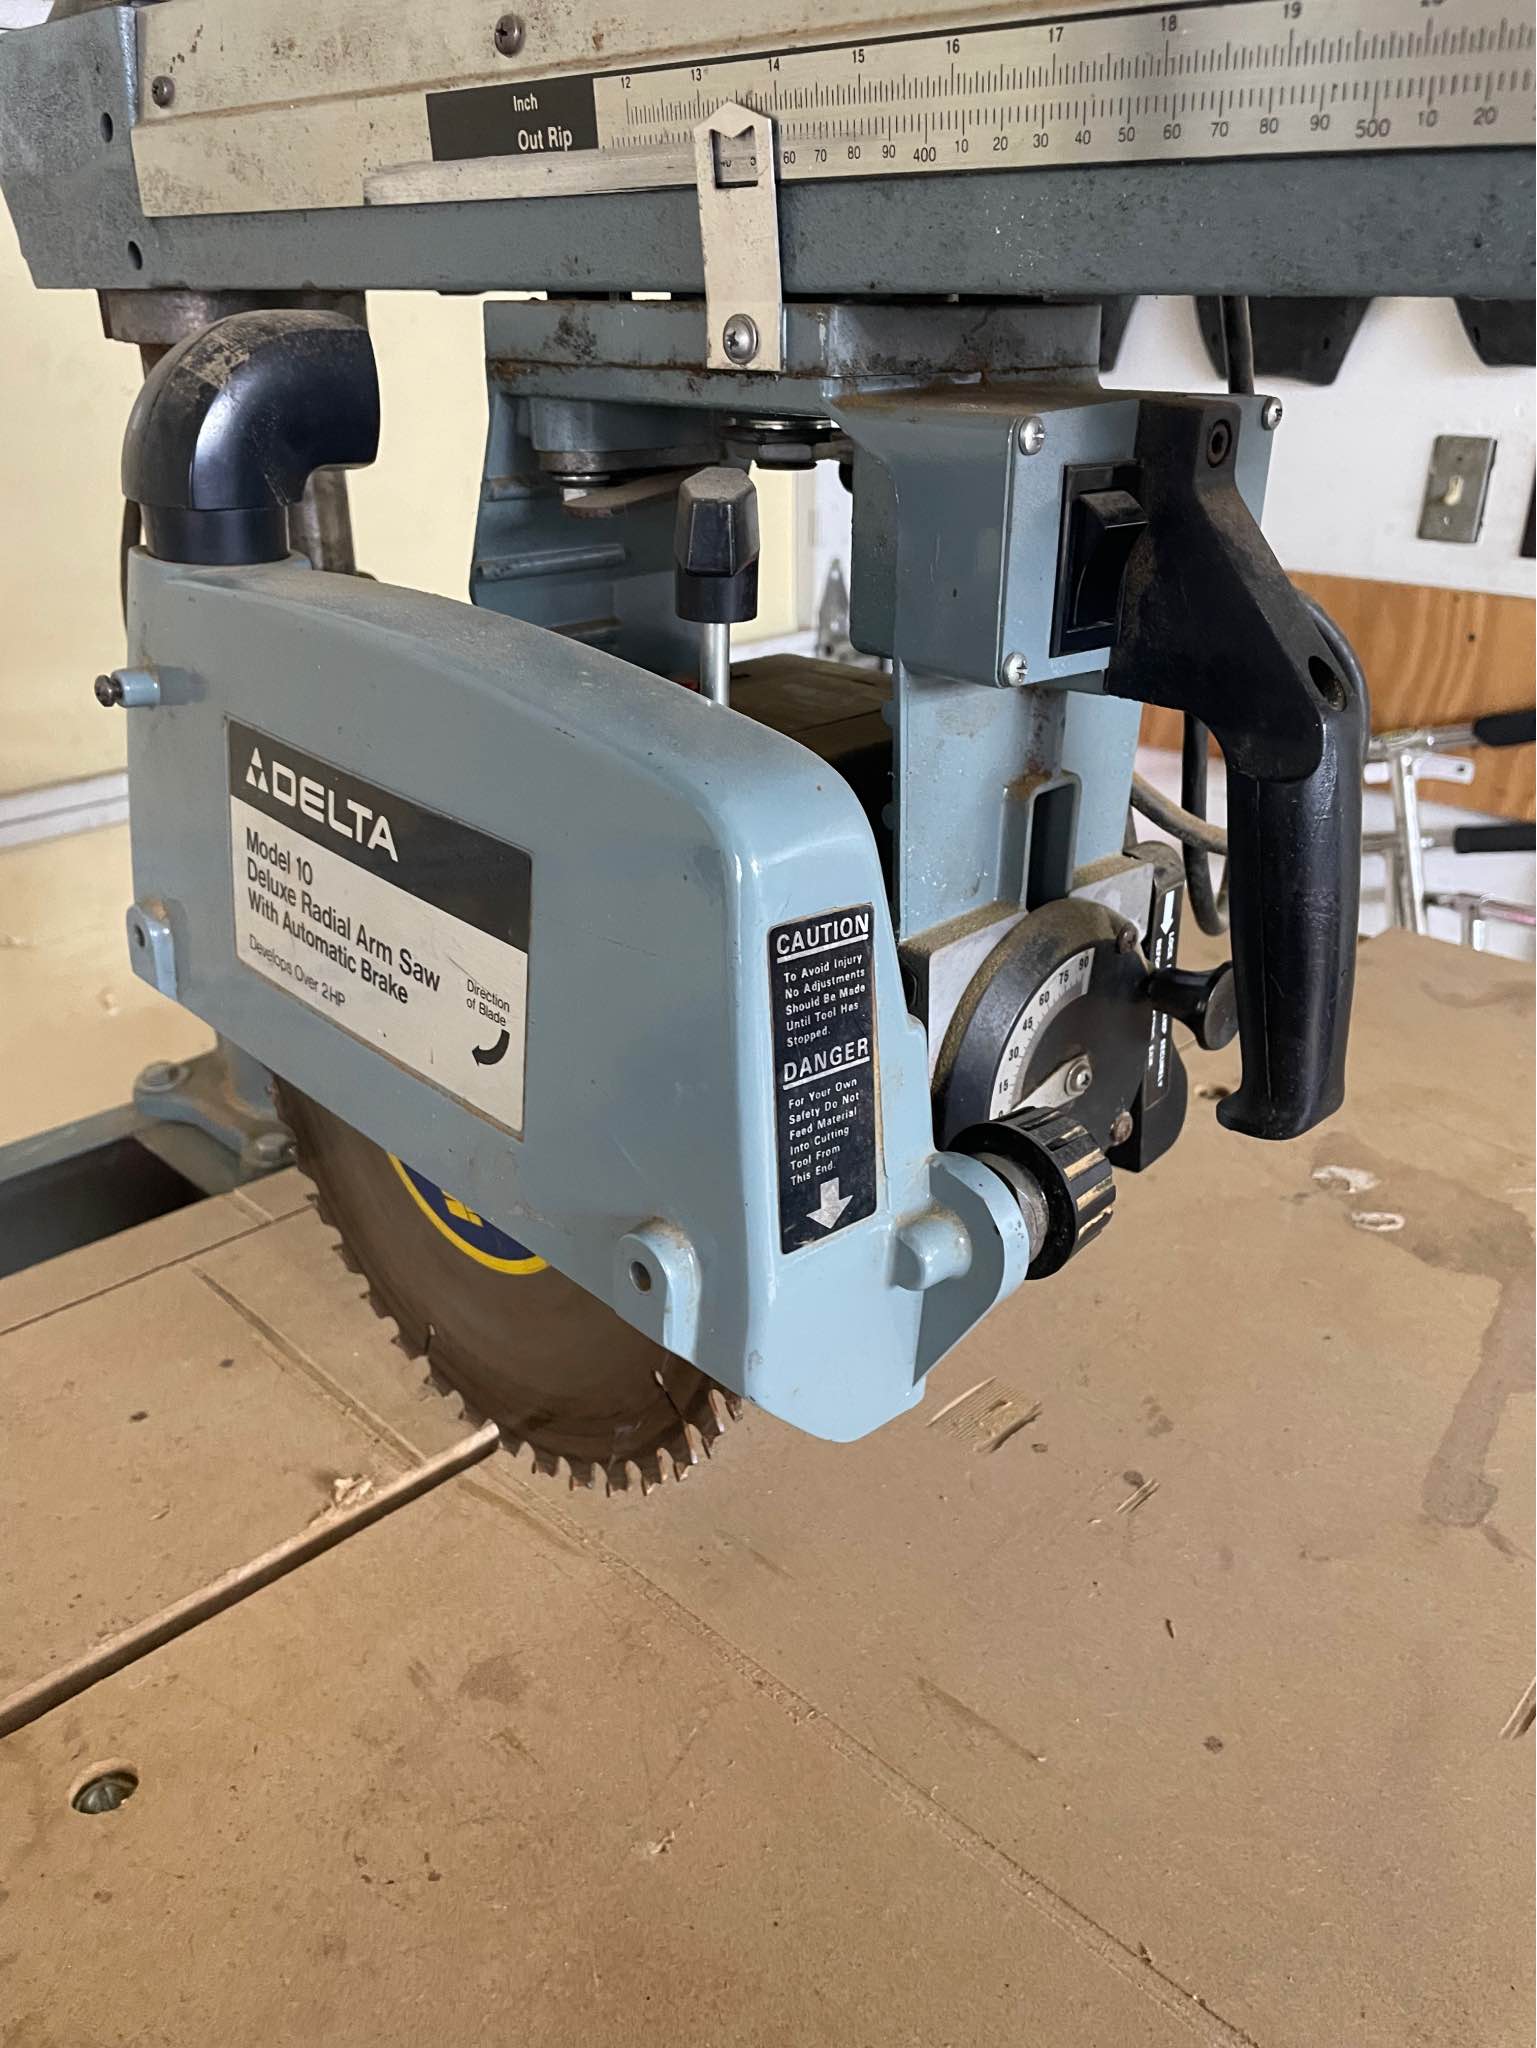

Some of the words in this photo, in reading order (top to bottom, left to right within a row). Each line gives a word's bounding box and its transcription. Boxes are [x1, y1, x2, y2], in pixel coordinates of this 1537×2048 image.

[621, 76, 631, 89] 12
[691, 68, 702, 81] 13
[768, 57, 780, 71] 14
[852, 49, 865, 63] 15
[946, 38, 960, 54] 16
[1049, 26, 1064, 43] 17
[1160, 14, 1177, 32] 18
[1283, 2, 1302, 19] 19
[513, 92, 538, 112] Inch
[518, 129, 544, 150] Out
[547, 125, 573, 152] Rip
[783, 151, 796, 164] 60
[815, 149, 827, 162] 70
[848, 145, 861, 160] 80
[882, 144, 896, 159] 90
[913, 147, 937, 162] 400
[955, 138, 969, 153] 10
[993, 136, 1008, 151] 20
[1033, 132, 1049, 148] 30
[1075, 130, 1091, 144] 40
[1118, 127, 1136, 142] 50
[1163, 123, 1181, 140] 60
[1211, 121, 1229, 138] 70
[1259, 117, 1279, 134] 80
[1310, 114, 1330, 132] 90
[1355, 118, 1391, 138] 500
[1418, 110, 1438, 127] 10
[1473, 106, 1497, 126] 20
[272, 760, 398, 862] DELTA
[246, 826, 290, 874] Model
[296, 856, 313, 886] 10
[248, 856, 296, 907] Deluxe
[302, 890, 350, 940] Radial
[356, 924, 392, 966] Arm
[399, 948, 440, 992] Saw
[776, 913, 869, 955] CAUTION
[248, 887, 278, 925] With
[283, 911, 356, 973] Automatic
[361, 958, 408, 1004] Brake
[249, 934, 292, 975] Develops
[294, 964, 319, 992] Over
[784, 972, 797, 983] To
[801, 961, 829, 978] Avoid
[834, 954, 862, 969] Injury
[467, 979, 509, 1012] Direction
[785, 988, 799, 999] No
[803, 969, 865, 994] Adjustments
[786, 995, 820, 1016] Should
[823, 993, 836, 1003] Be
[839, 984, 865, 999] Made
[467, 998, 476, 1010] of
[479, 1002, 506, 1026] Blade
[786, 1015, 811, 1031] Until
[814, 1006, 836, 1022] Tool
[841, 1002, 859, 1014] Has
[999, 1079, 1009, 1094] 15
[1008, 1046, 1019, 1061] 30
[1022, 1017, 1033, 1032] 45
[1039, 991, 1050, 1006] 60
[1059, 970, 1069, 985] 75
[1078, 955, 1089, 971] 90
[787, 1025, 830, 1048] Stopped.
[783, 1037, 869, 1082] DANGER
[788, 1098, 804, 1109] For
[808, 1088, 831, 1101] Your
[835, 1079, 857, 1092] Own
[789, 1107, 820, 1125] Safety
[824, 1101, 837, 1112] Do
[842, 1092, 859, 1105] Not
[789, 1123, 813, 1141] Feed
[817, 1106, 857, 1130] Material
[790, 1142, 810, 1156] Into
[814, 1126, 850, 1146] Cutting
[790, 1154, 811, 1170] Tool
[816, 1145, 840, 1161] From
[790, 1171, 811, 1186] This
